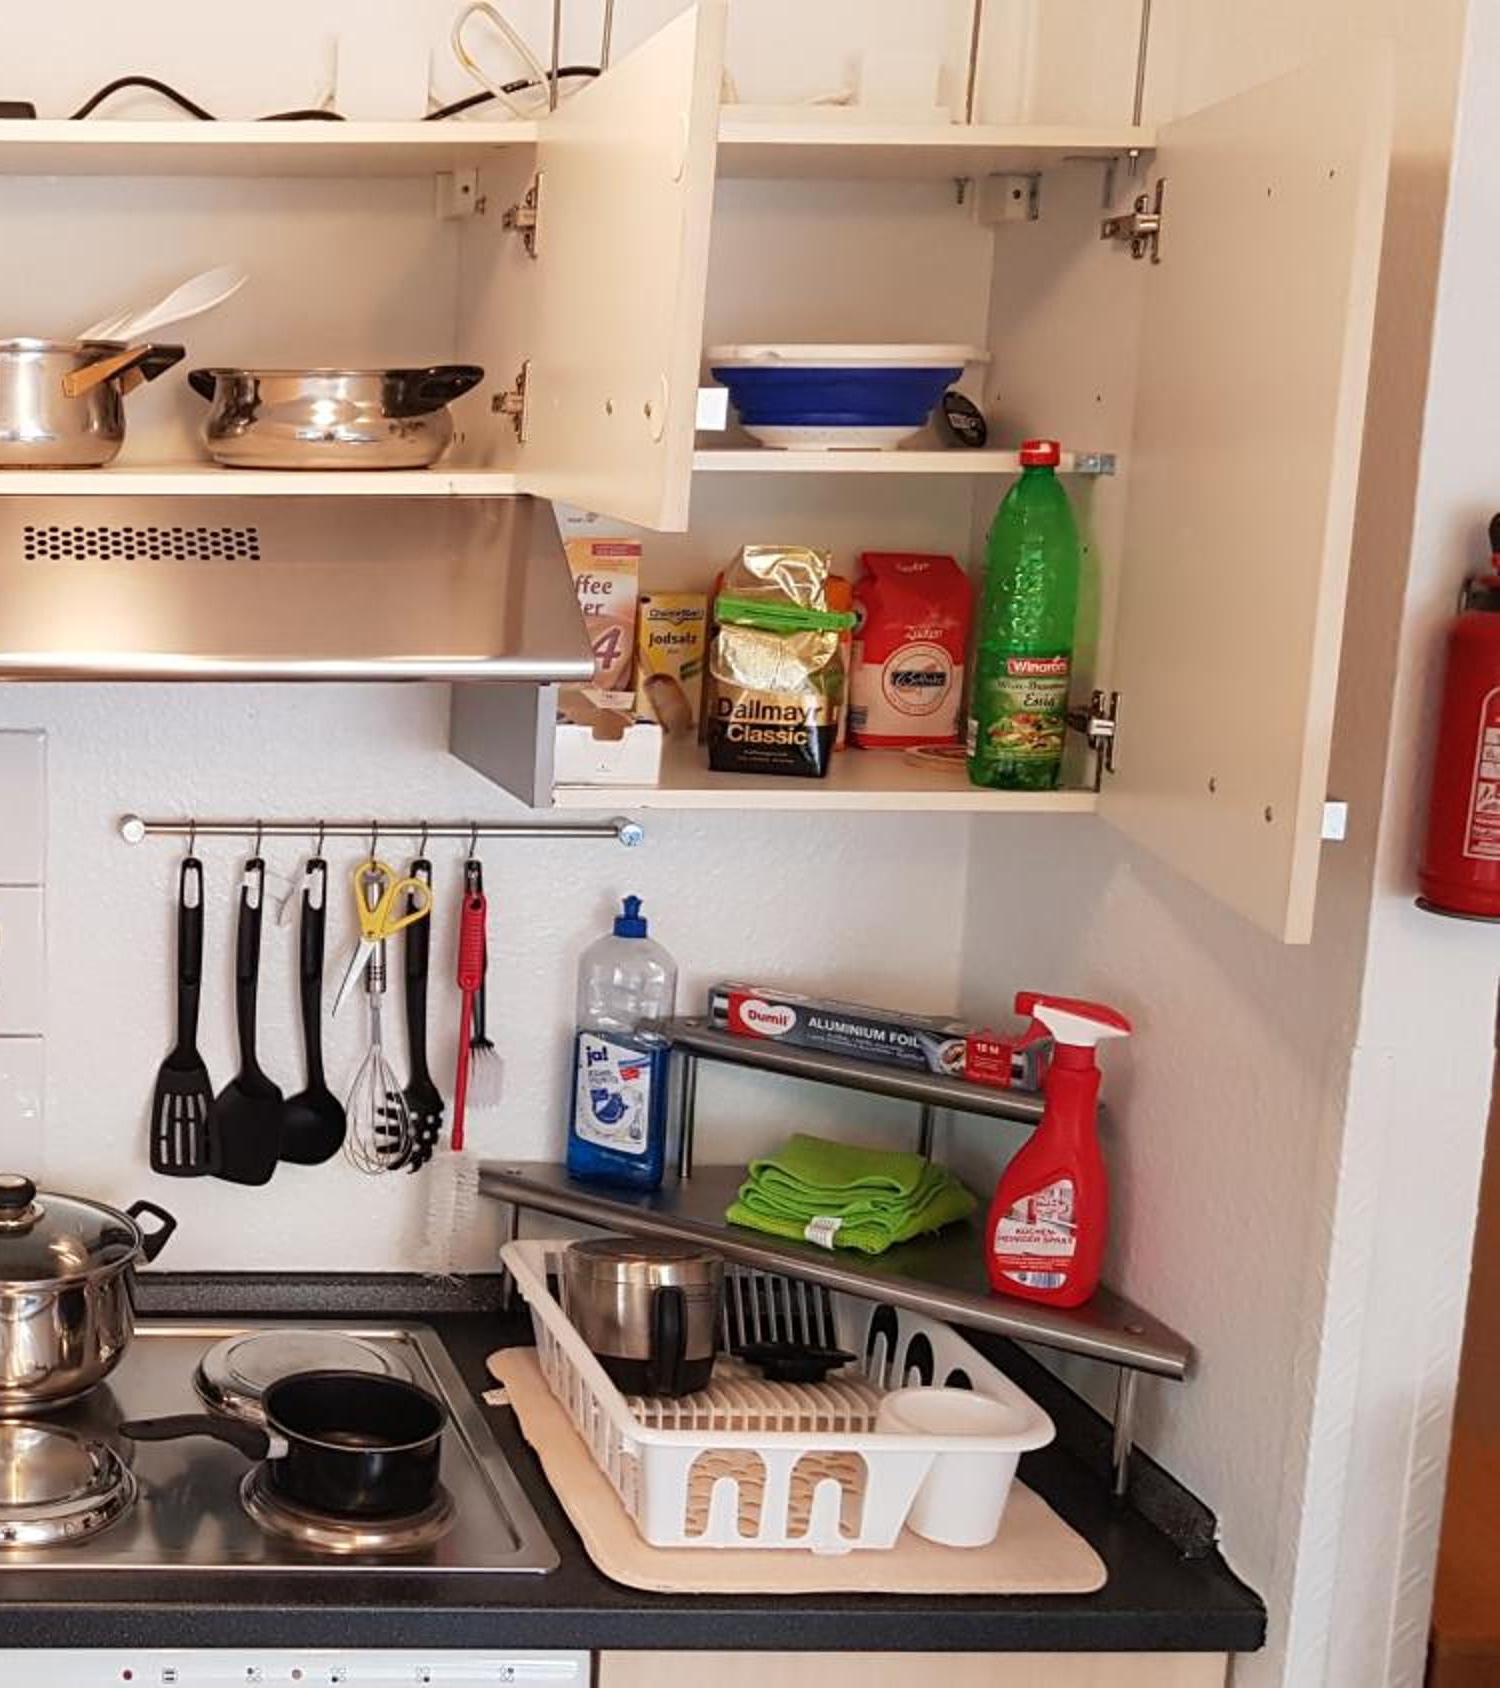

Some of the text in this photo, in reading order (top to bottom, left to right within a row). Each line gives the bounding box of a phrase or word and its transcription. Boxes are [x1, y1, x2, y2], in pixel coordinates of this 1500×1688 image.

[574, 573, 613, 596] ffee
[593, 627, 622, 670] 4
[648, 630, 698, 648] Jodsalz
[717, 697, 823, 726] Dallmayr
[726, 722, 808, 746] Classic
[807, 1016, 886, 1043] ALUMINIUM
[889, 1033, 920, 1048] FOIL
[585, 1045, 609, 1067] ja!
